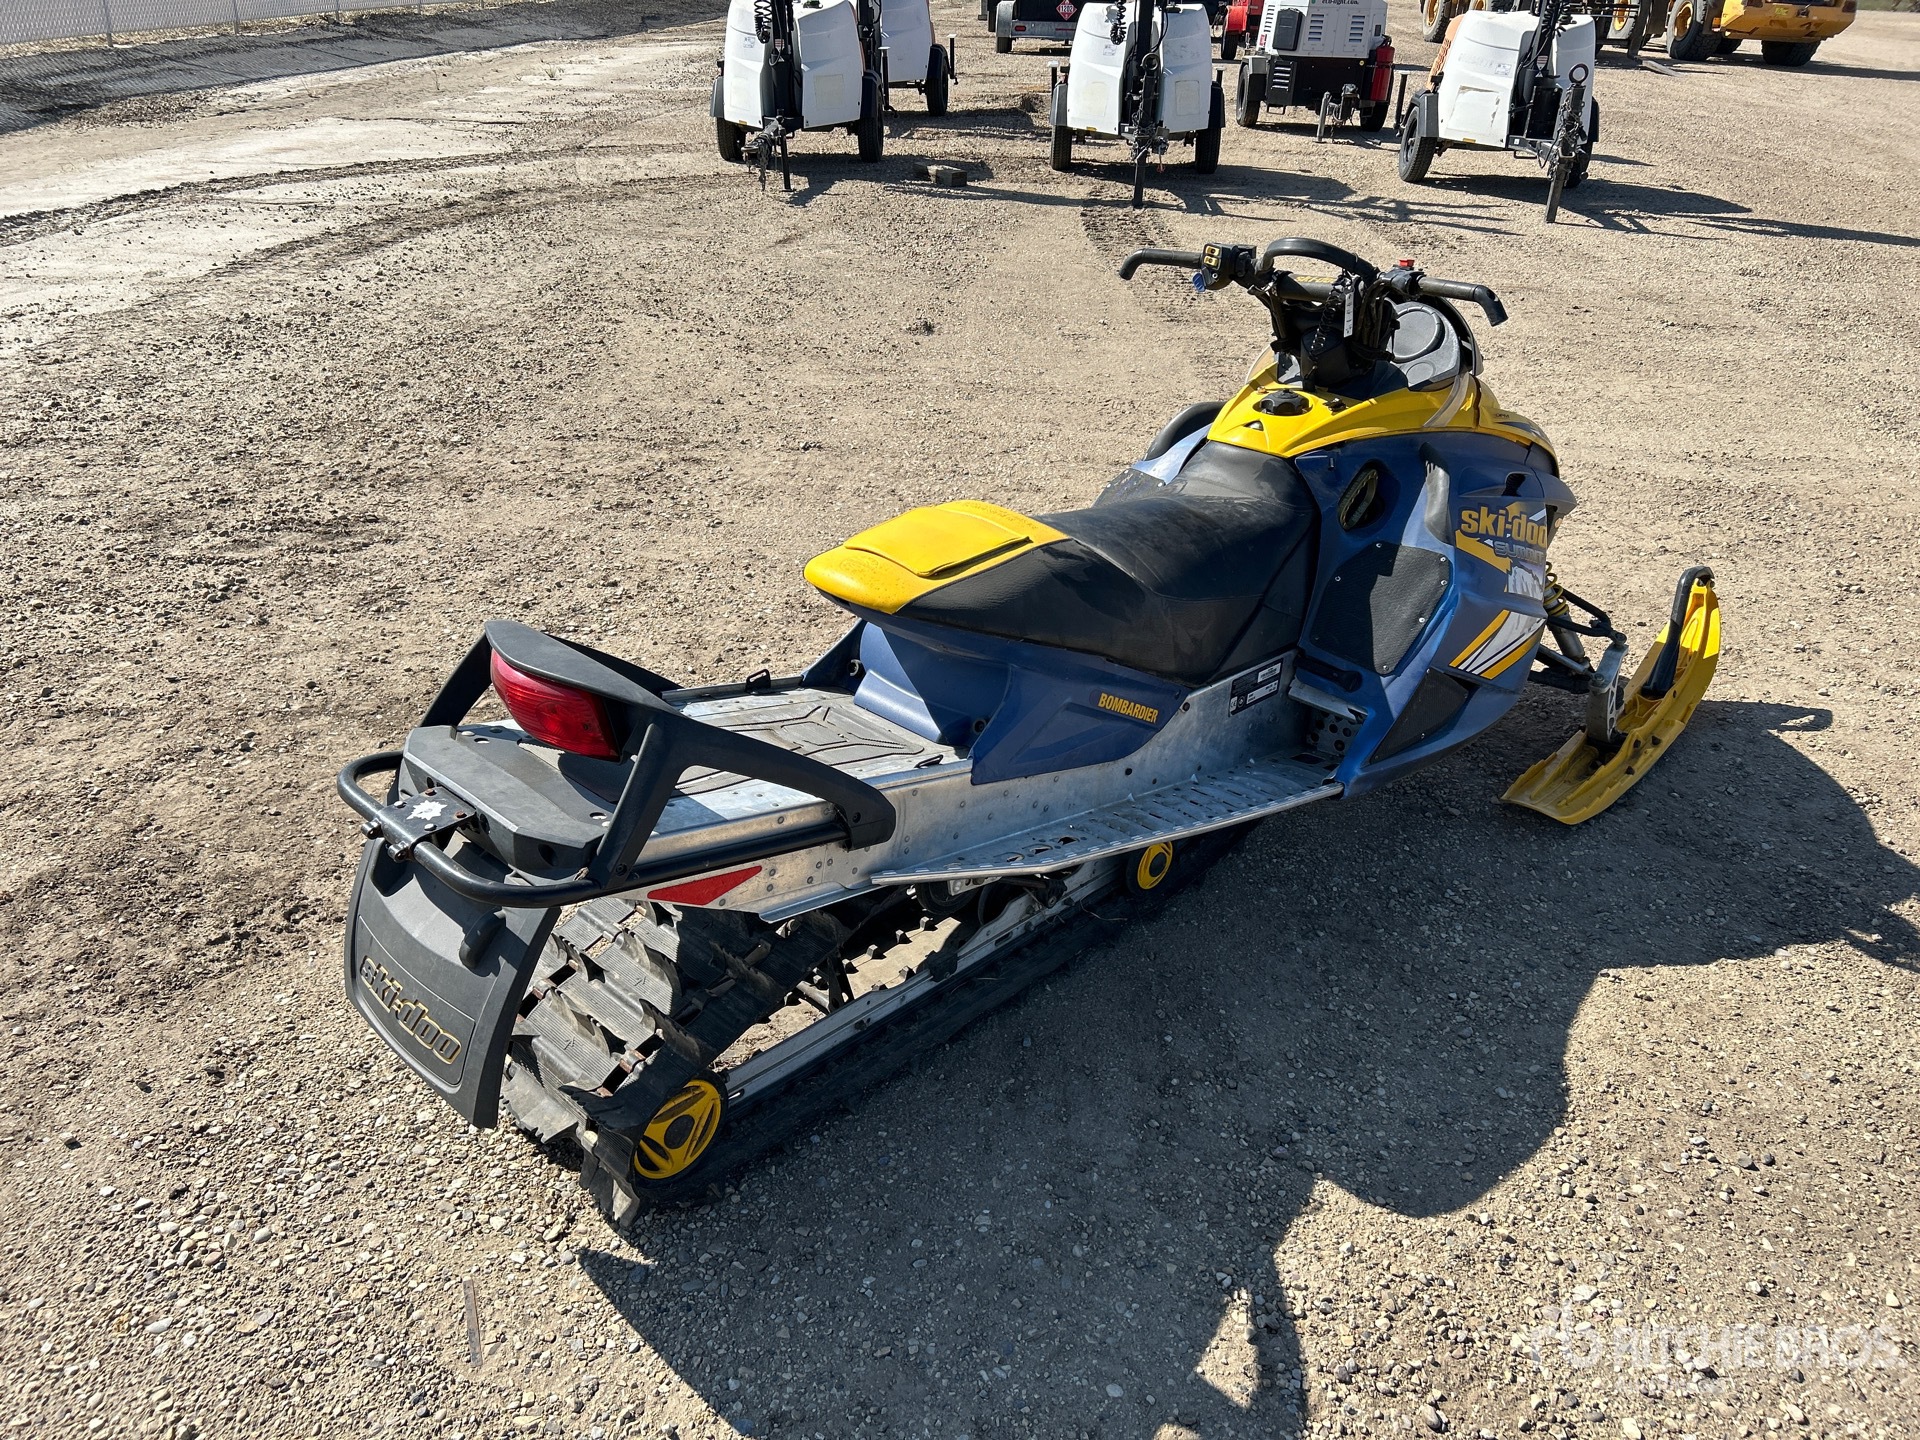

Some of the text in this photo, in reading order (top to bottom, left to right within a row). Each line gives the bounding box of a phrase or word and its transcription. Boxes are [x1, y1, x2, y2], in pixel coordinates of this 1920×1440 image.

[1461, 506, 1547, 548] ski-doo
[1098, 692, 1159, 724] BOMBARDIER
[360, 955, 462, 1065] ski-doo
